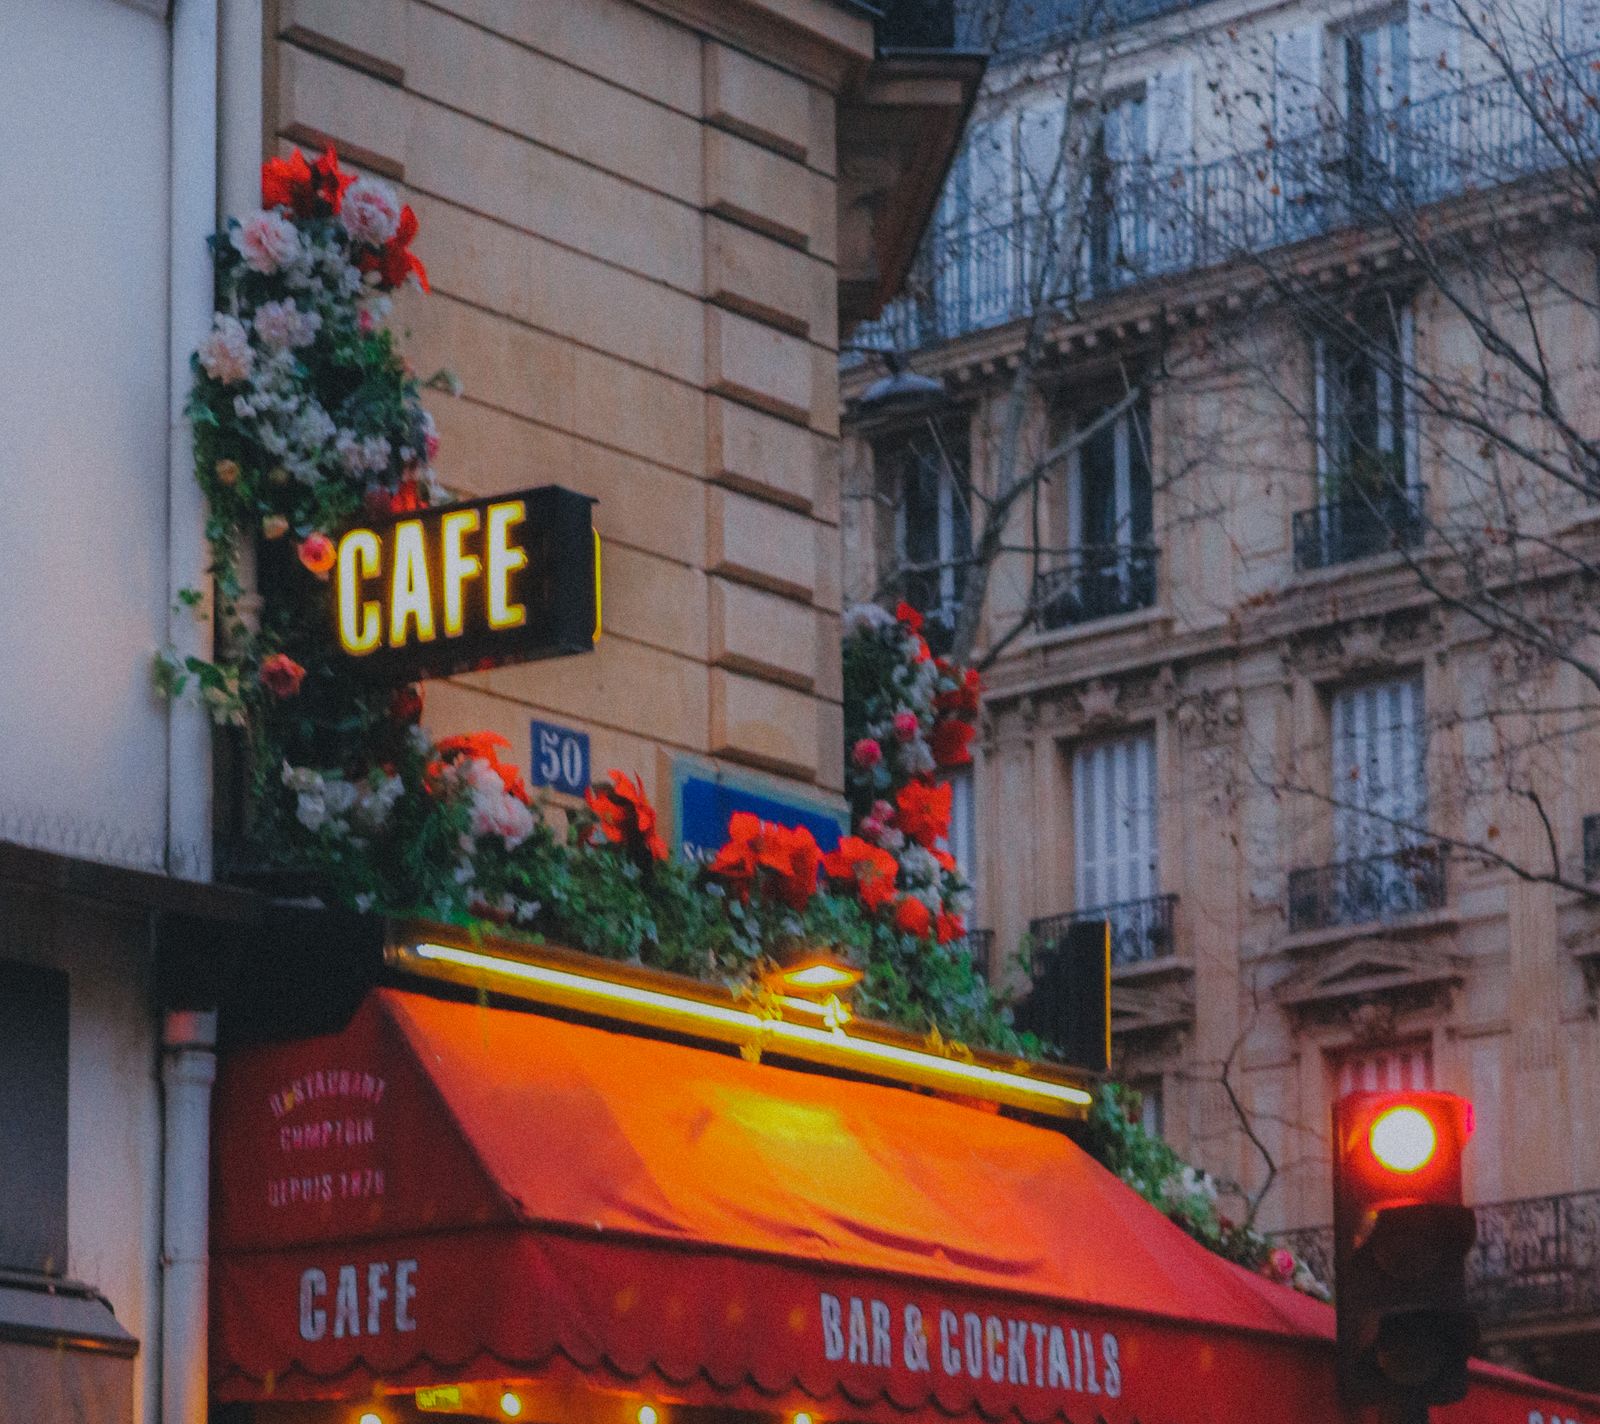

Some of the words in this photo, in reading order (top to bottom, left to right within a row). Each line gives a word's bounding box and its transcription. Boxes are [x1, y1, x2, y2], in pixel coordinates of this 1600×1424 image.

[338, 500, 528, 656] CAFE
[540, 729, 583, 788] 50
[299, 1258, 418, 1342] CAFE
[820, 1292, 892, 1368] BAR
[903, 1303, 931, 1374] &
[939, 1308, 1122, 1399] COCKTAILS
